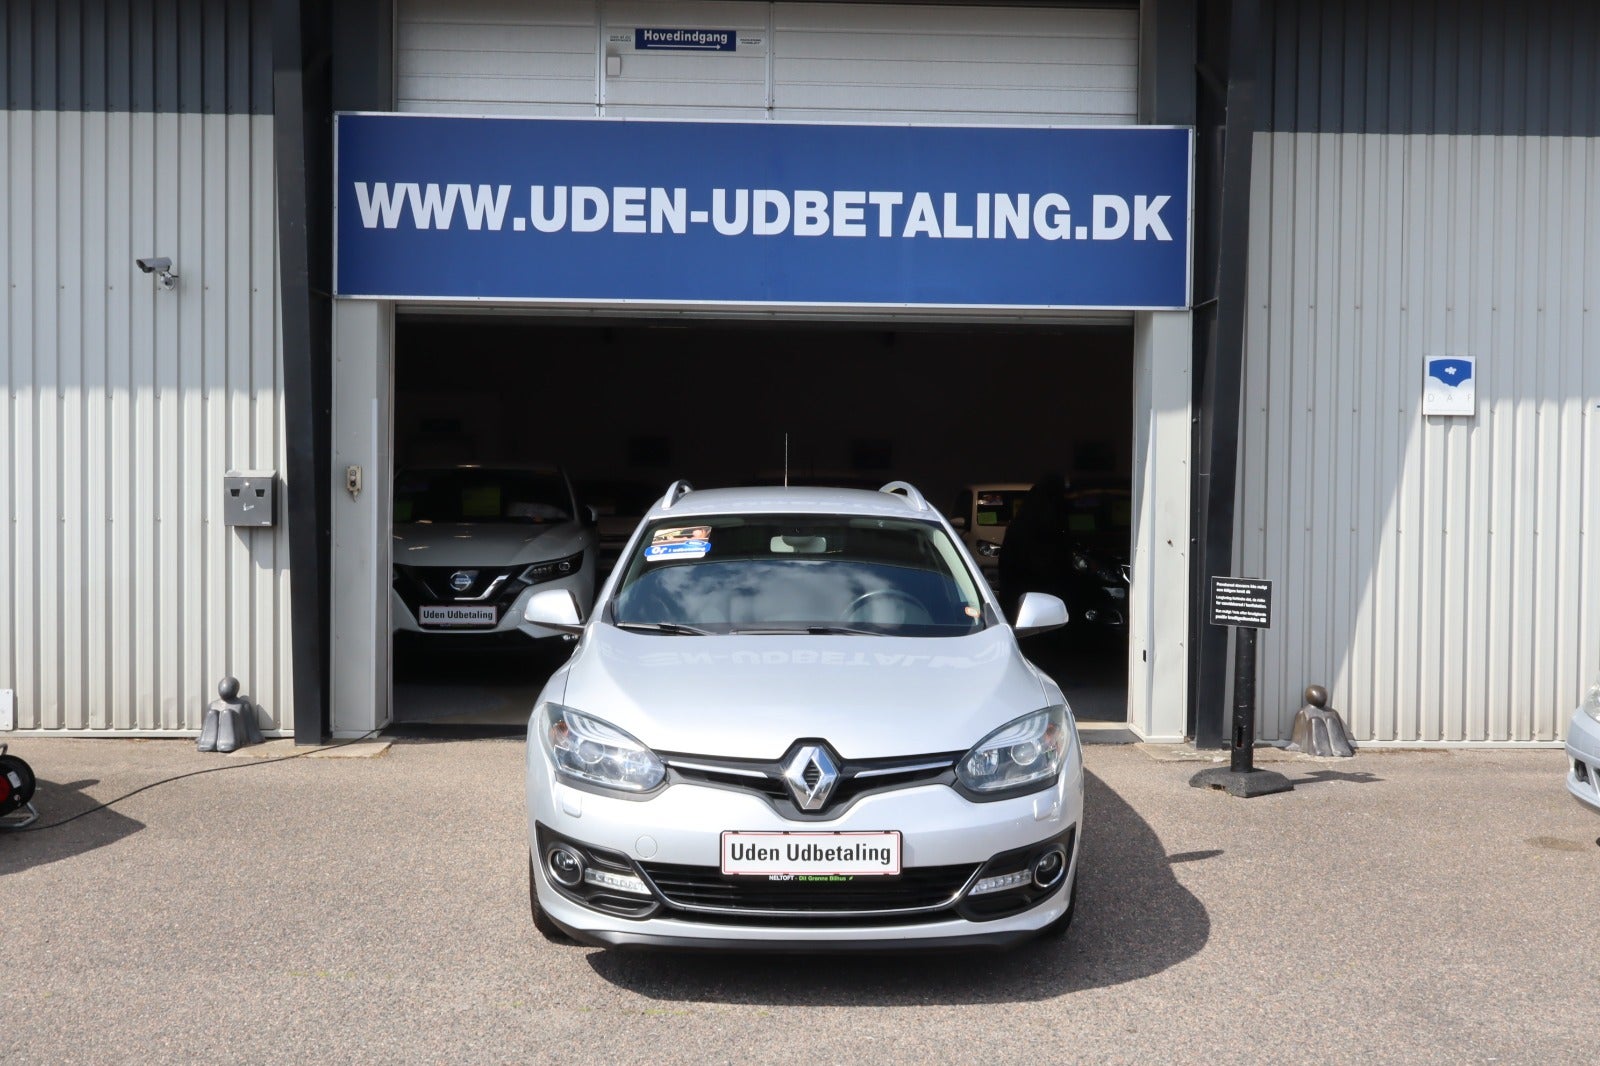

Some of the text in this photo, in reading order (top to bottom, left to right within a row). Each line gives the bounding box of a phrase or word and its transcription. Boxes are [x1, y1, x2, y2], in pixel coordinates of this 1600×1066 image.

[643, 30, 728, 44] Hovedindgang
[354, 181, 1173, 242] WWW.UDEN-UDBETALING.DK
[423, 610, 493, 621] Uden Udbetaling
[731, 843, 891, 865] Uden Udbetaling
